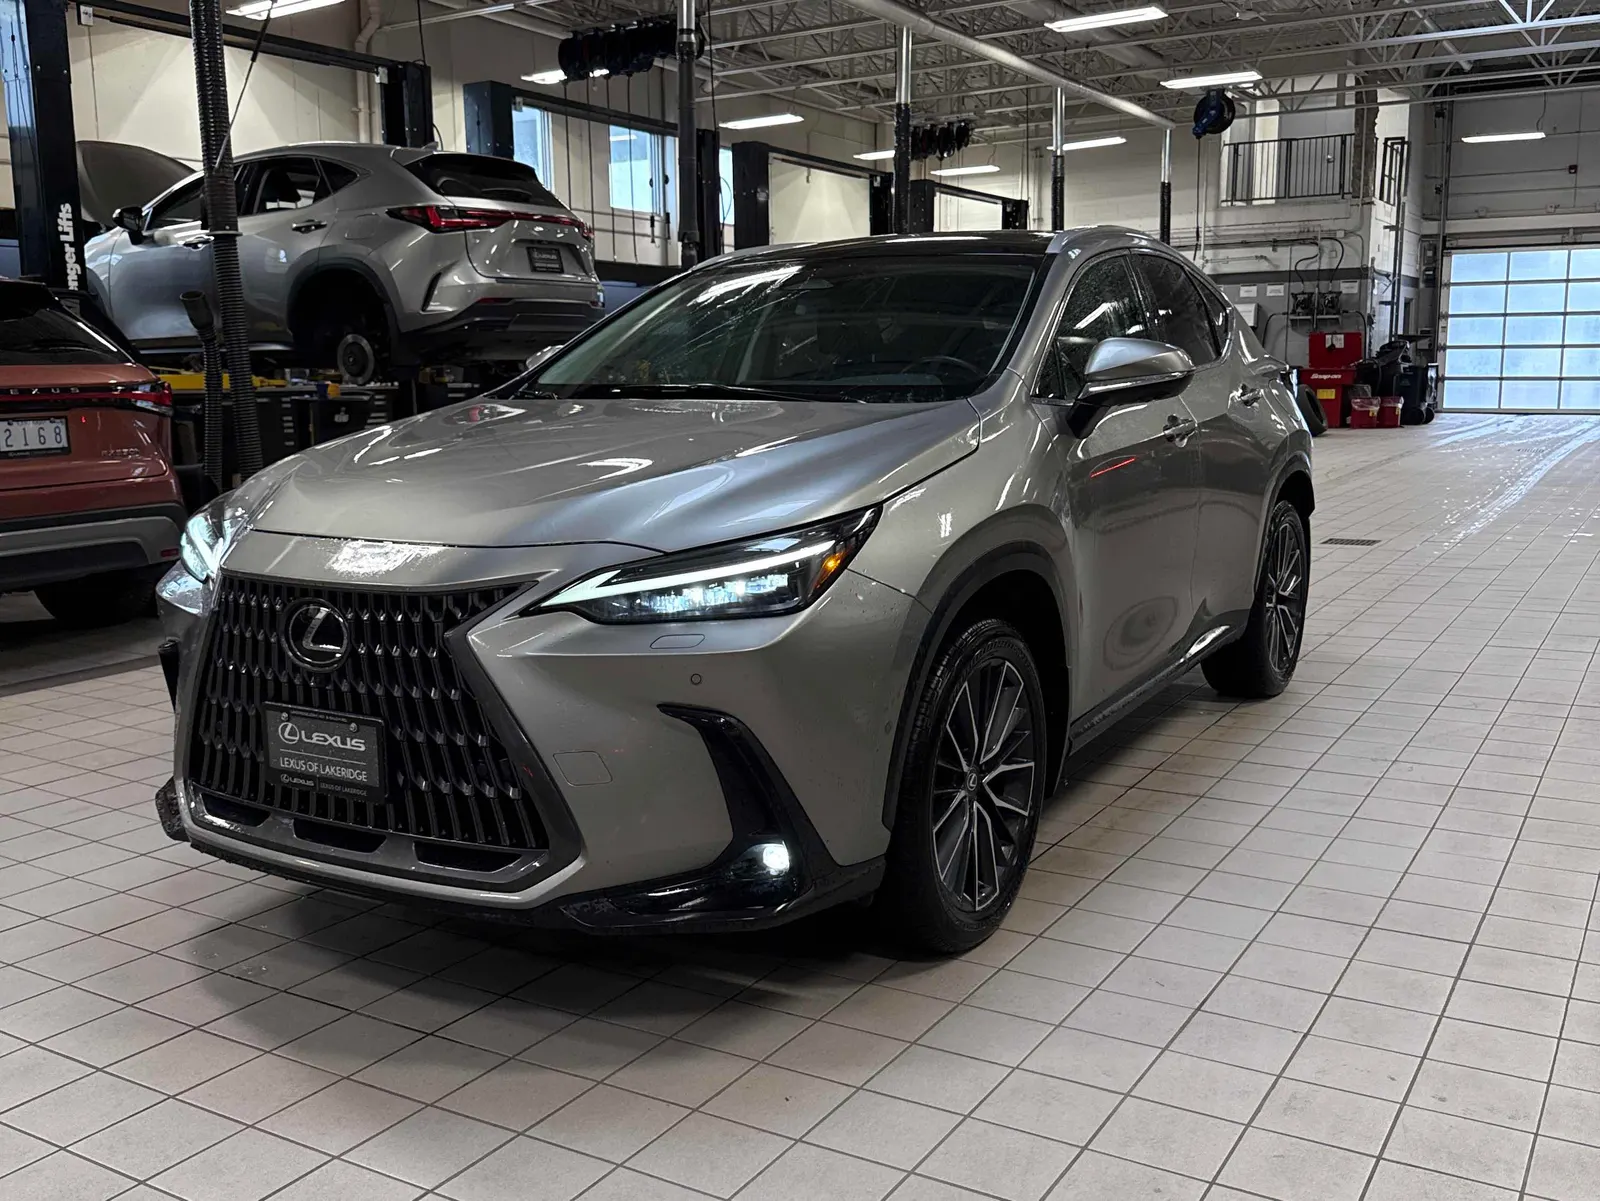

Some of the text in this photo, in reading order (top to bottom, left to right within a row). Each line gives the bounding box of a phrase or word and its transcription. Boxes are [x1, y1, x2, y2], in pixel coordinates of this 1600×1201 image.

[57, 203, 74, 241] Lifts
[4, 425, 63, 448] 2168
[301, 730, 366, 751] LEXUS
[280, 757, 368, 782] LEXUS OF LAKERIDGE
[289, 777, 315, 787] LEXUS
